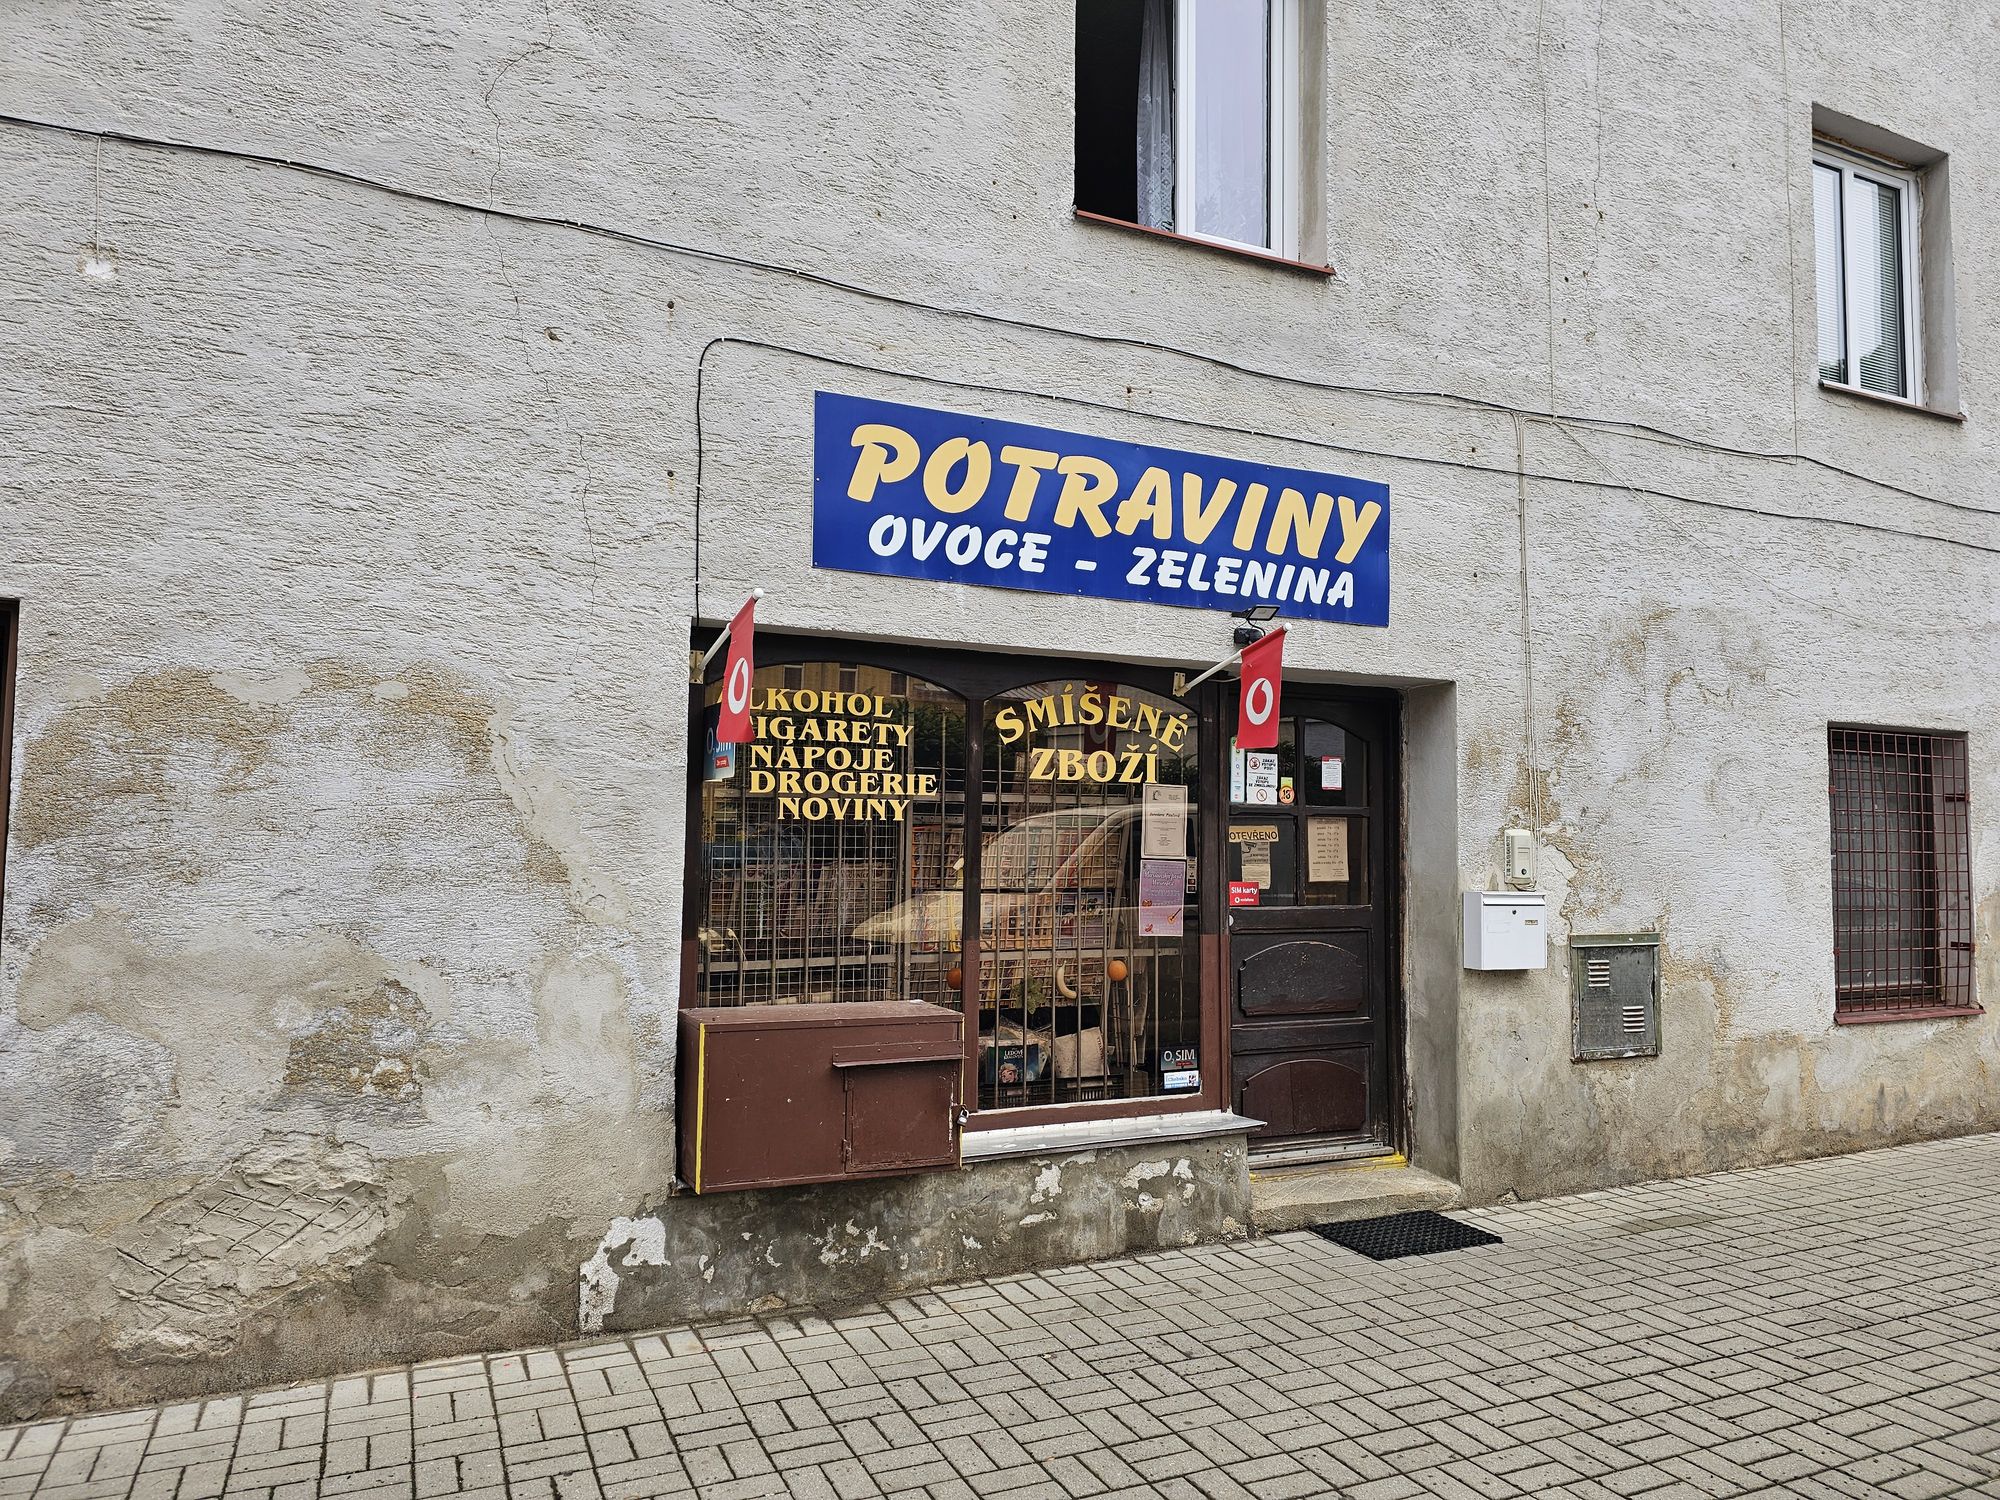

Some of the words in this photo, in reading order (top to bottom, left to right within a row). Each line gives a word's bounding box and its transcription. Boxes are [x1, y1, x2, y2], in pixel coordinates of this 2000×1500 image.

[847, 423, 1382, 565] POTRAVINY
[868, 514, 1052, 574] OVOCE
[1075, 559, 1096, 572] -
[1126, 546, 1354, 608] ZELENINA
[717, 687, 894, 719] LKOHOL
[995, 683, 1189, 753] SMÍŠENÉ
[750, 716, 914, 747] IGARETY
[750, 740, 895, 771] NÁPOJE
[1029, 743, 1158, 784] ZBOŽÍ
[750, 770, 938, 797] DROGERIE
[777, 797, 911, 821] NOVINY
[1229, 830, 1278, 841] OTEVŘENO
[1231, 886, 1242, 894] SIM
[1242, 886, 1258, 895] karty
[1175, 1049, 1195, 1061] SIM
